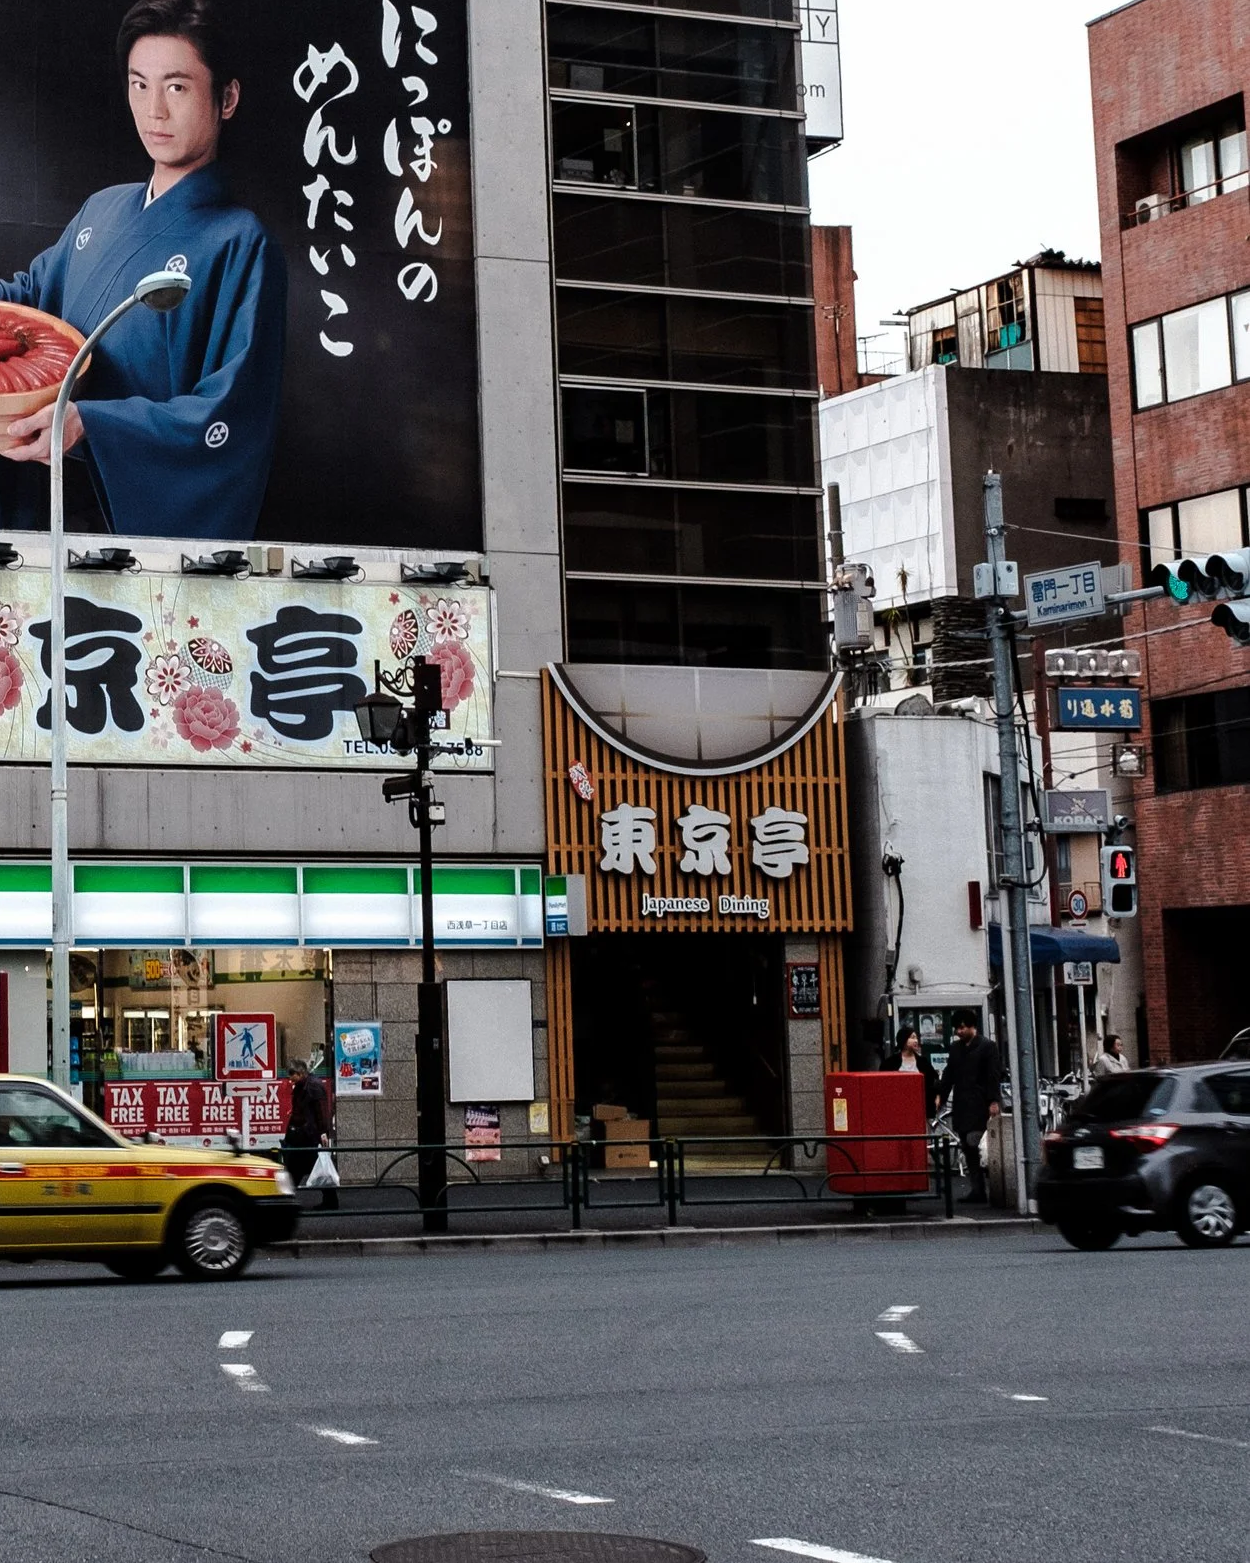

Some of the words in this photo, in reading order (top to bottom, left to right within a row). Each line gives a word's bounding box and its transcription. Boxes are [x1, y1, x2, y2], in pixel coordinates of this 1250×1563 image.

[293, 42, 360, 358] めんたいこ
[1031, 570, 1096, 603] 雷門一丁目
[1037, 599, 1088, 617] Kaminarimon
[600, 803, 810, 879] 東京亭
[642, 894, 710, 917] Japanese
[718, 895, 770, 918] Dining
[1072, 898, 1085, 912] 30
[111, 1087, 143, 1106] TAX
[157, 1086, 189, 1105] TAX
[111, 1106, 144, 1123] FREE
[157, 1106, 190, 1122] FREE
[202, 1106, 235, 1122] FREE
[249, 1105, 281, 1120] FREE
